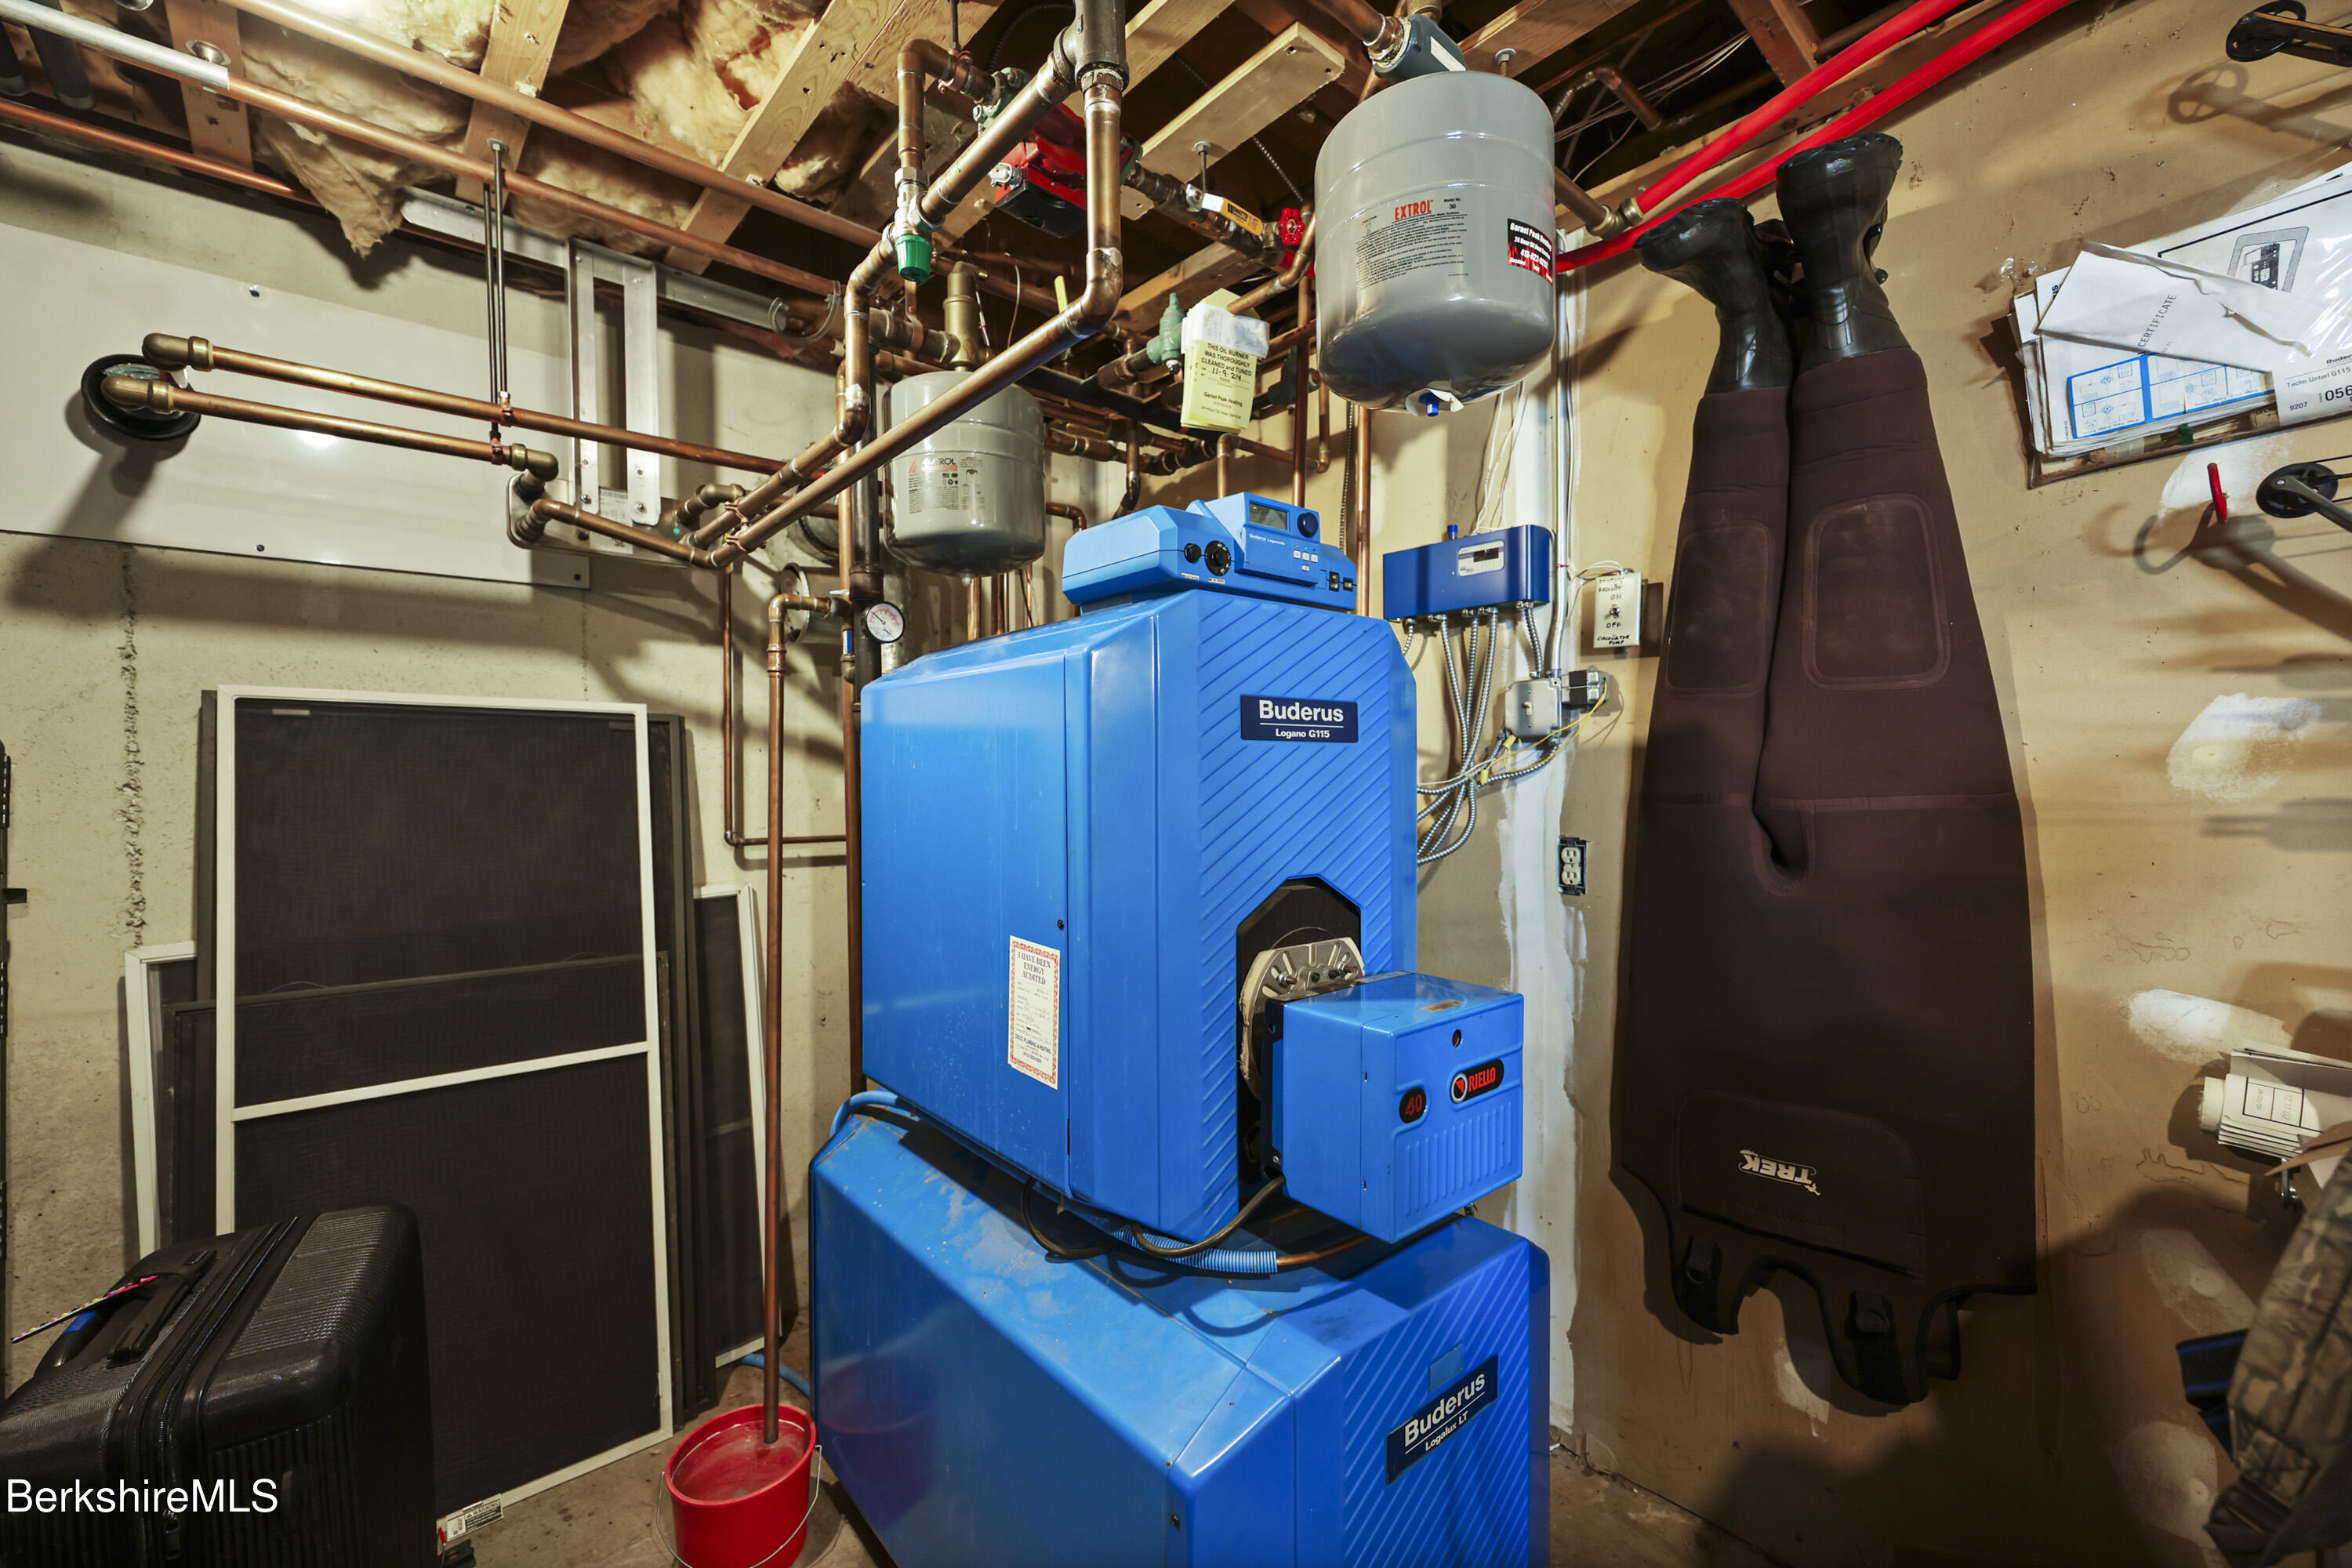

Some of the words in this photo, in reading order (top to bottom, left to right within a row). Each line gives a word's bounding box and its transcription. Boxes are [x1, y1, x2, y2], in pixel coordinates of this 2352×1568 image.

[1395, 199, 1432, 220] EXTROL
[2137, 294, 2177, 347] CERTIFICATE
[1218, 354, 1250, 368] THOROUGHLY
[1229, 350, 1249, 360] BURNER
[1201, 358, 1225, 368] CLEANED
[2287, 379, 2307, 388] Techn
[1228, 398, 1243, 407] Heating
[2289, 401, 2307, 411] 9207
[1258, 699, 1345, 723] Buderus
[1275, 728, 1307, 739] Logano
[1308, 729, 1330, 739] G115
[1021, 952, 1036, 964] HAVE
[1036, 956, 1051, 968] BEEN
[1023, 962, 1044, 975] ENERGY
[1022, 971, 1046, 985] AUDITED
[1468, 1067, 1497, 1092] RIELLO
[1405, 1094, 1423, 1116] 40
[1741, 1154, 1813, 1185] TREK
[1404, 1374, 1485, 1447] Buderus
[1425, 1422, 1457, 1451] Logalux
[1458, 1410, 1468, 1425] LT
